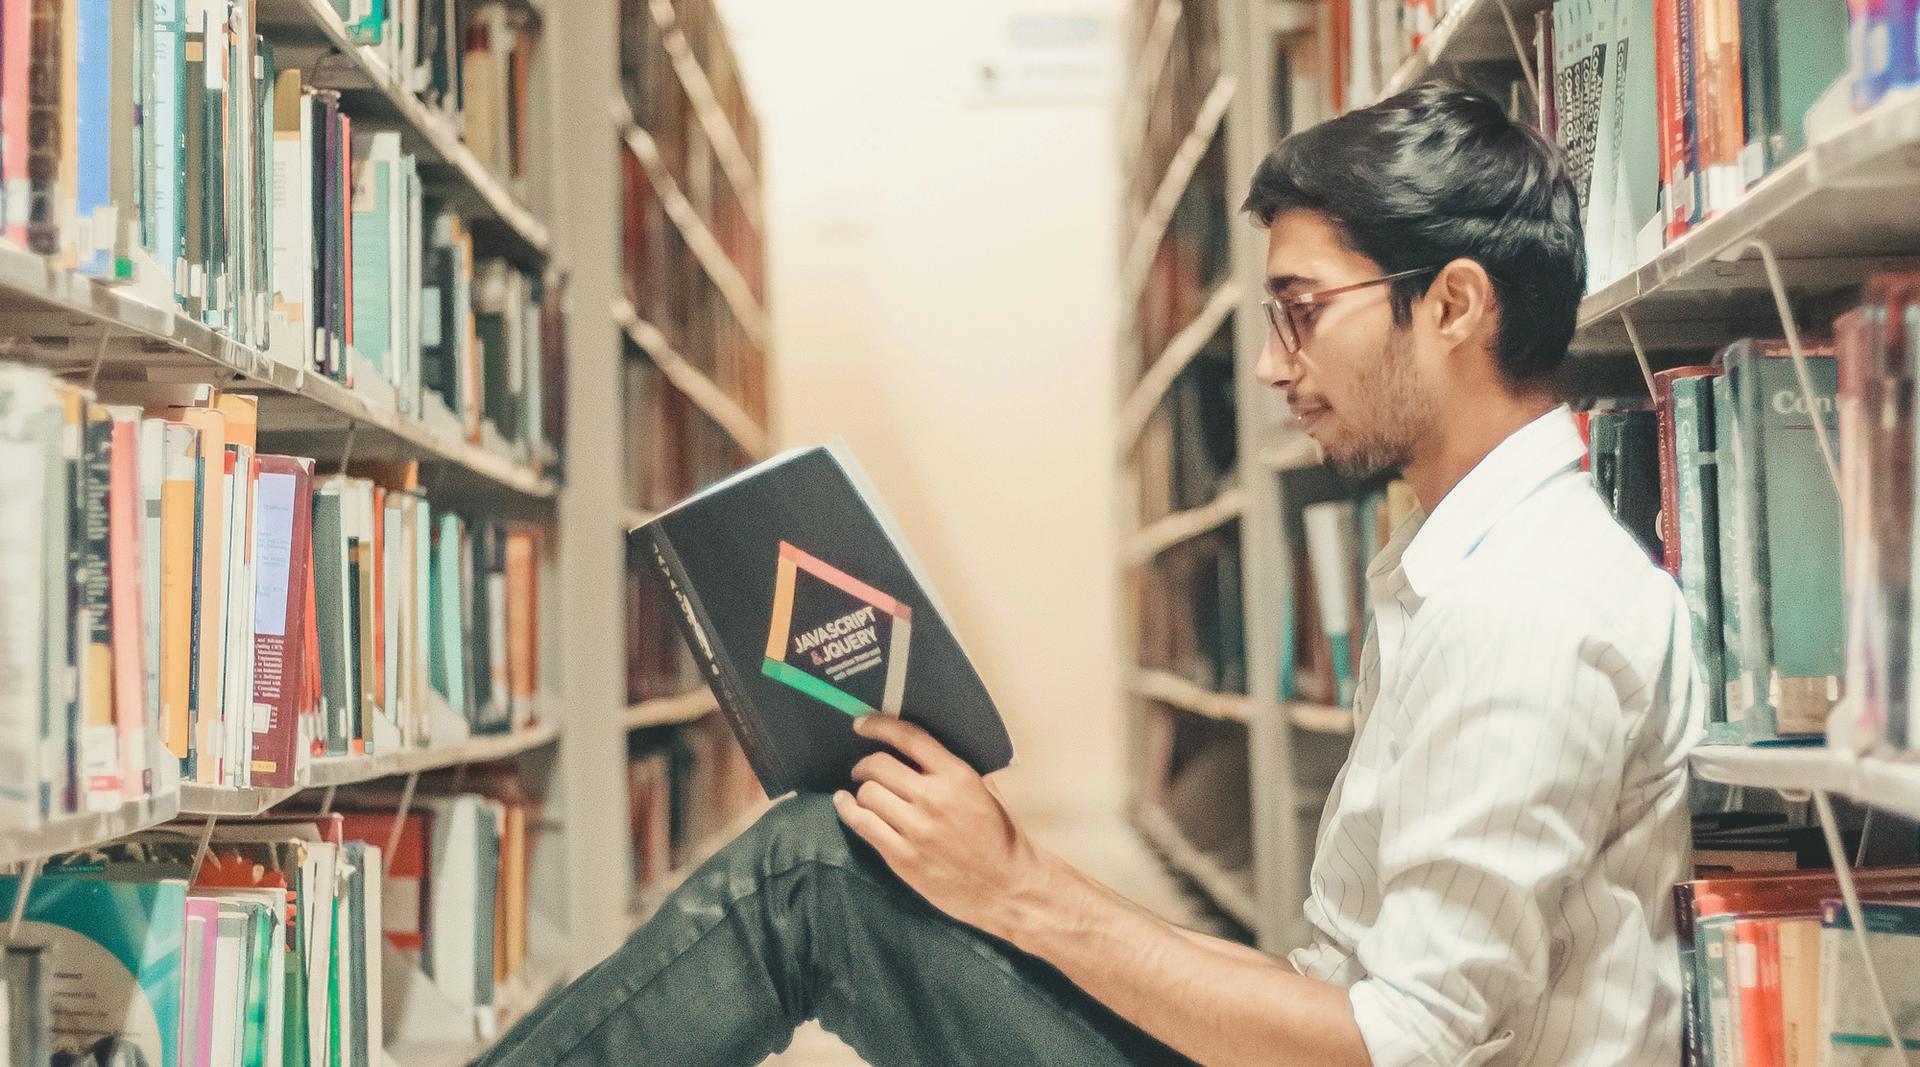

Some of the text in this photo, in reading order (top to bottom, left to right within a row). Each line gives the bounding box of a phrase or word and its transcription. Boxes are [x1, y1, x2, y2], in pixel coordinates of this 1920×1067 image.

[1564, 68, 1574, 144] CONTROL
[1658, 411, 1667, 480] Modern
[1663, 488, 1672, 554] Control
[795, 607, 876, 654] JAVASCRIPT
[823, 626, 877, 662] JQUERY
